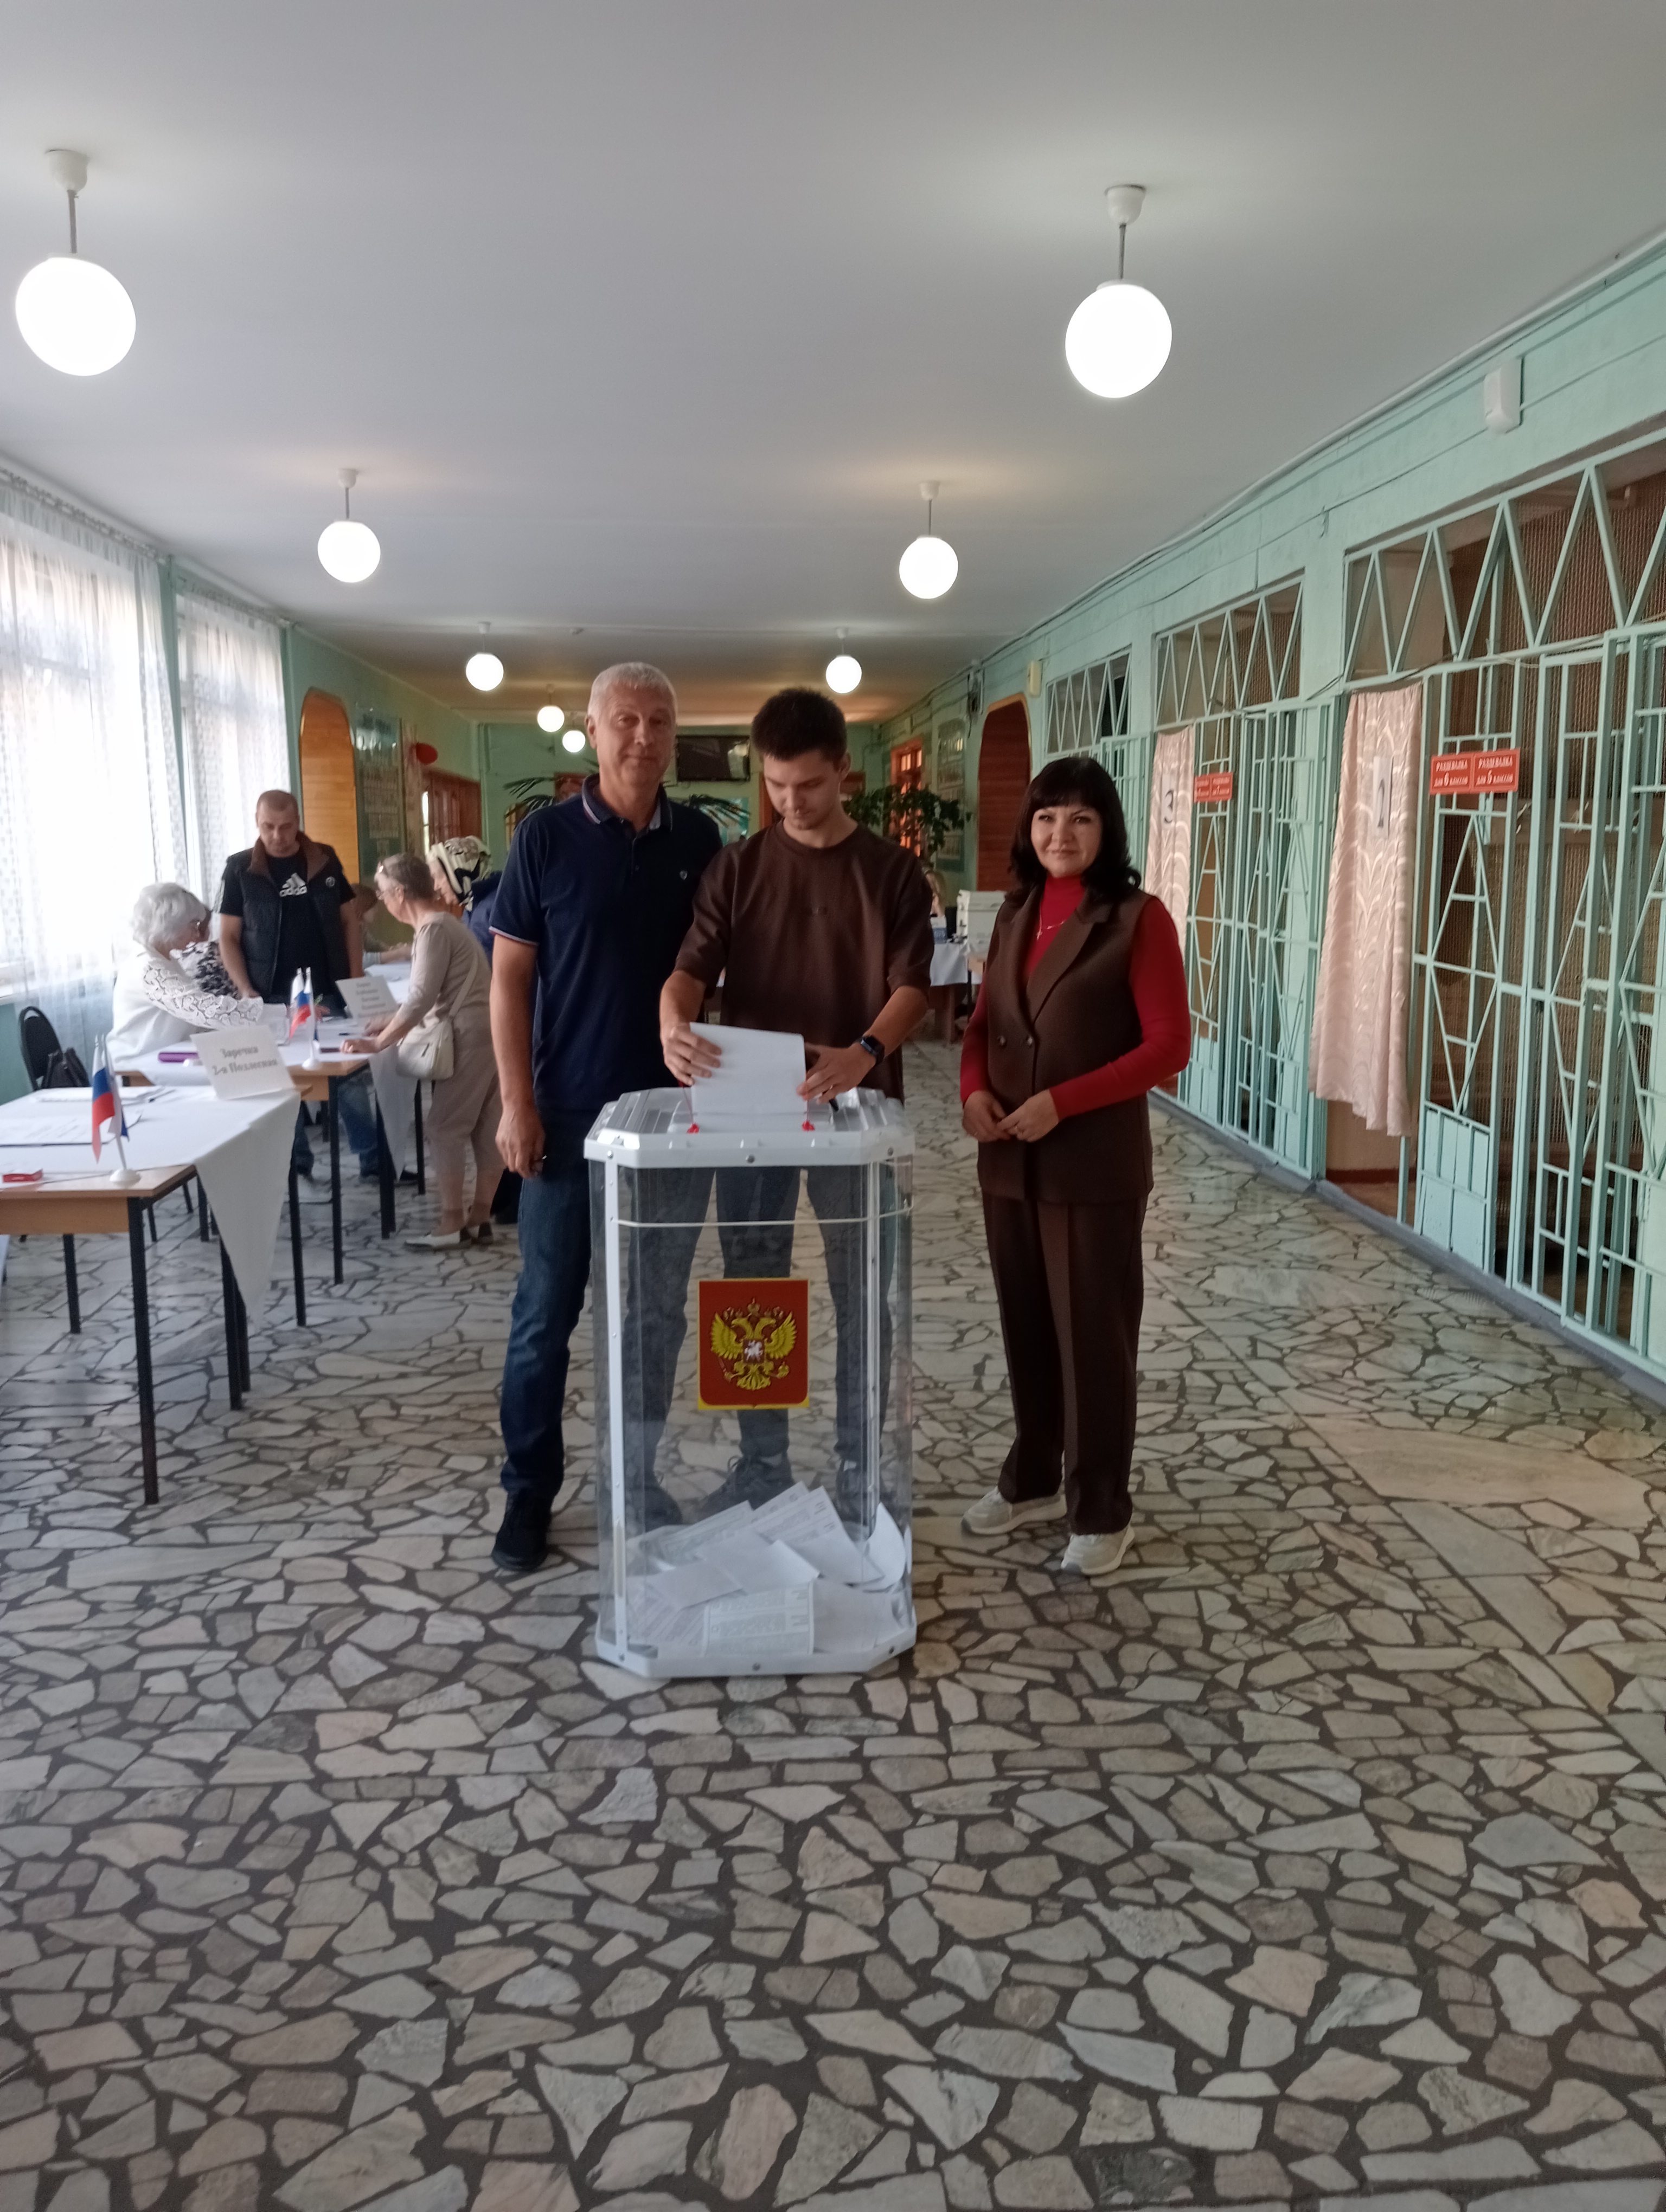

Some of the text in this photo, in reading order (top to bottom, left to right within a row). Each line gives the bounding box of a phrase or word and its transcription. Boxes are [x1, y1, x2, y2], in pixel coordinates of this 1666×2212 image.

[1444, 772, 1449, 786] 6
[1164, 789, 1174, 824] 3
[1377, 779, 1385, 828] 2
